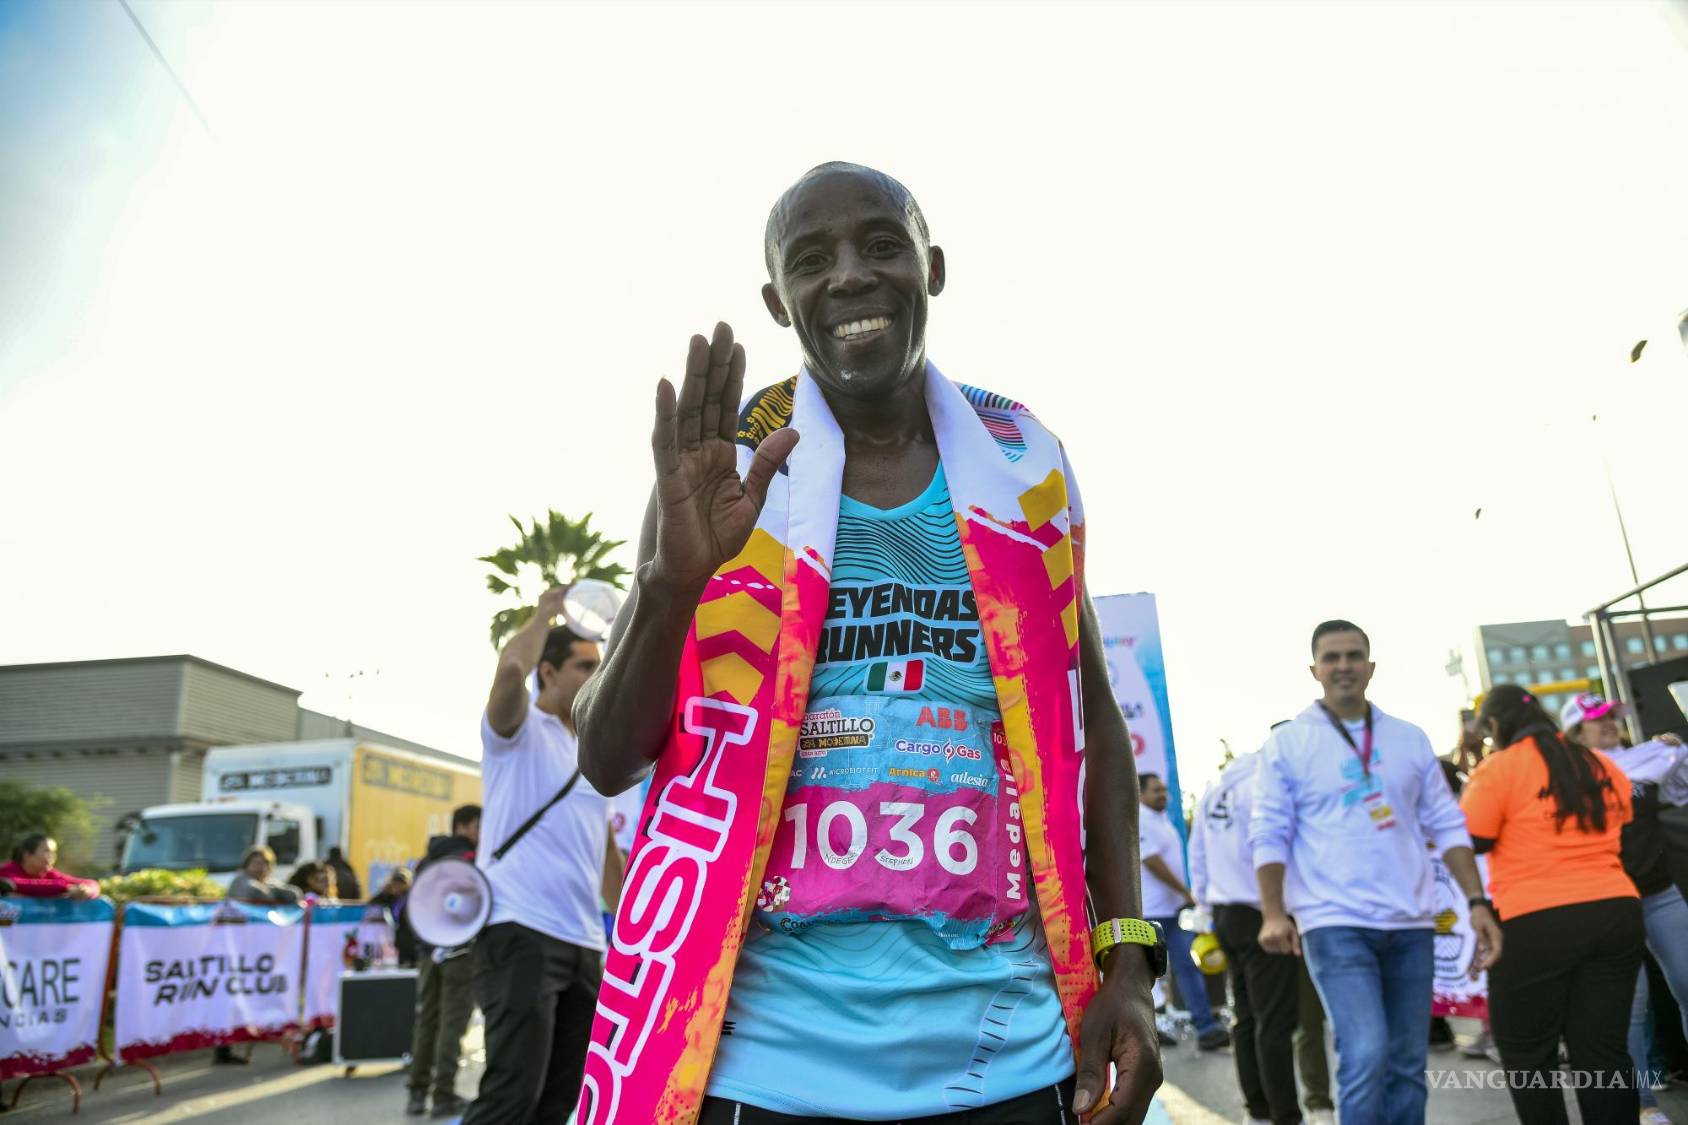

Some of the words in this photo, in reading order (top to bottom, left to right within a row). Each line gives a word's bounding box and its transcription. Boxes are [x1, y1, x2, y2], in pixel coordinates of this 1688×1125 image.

[827, 583, 981, 621] EYENDAS
[801, 718, 874, 737] SALTILLO
[916, 706, 968, 731] ABB
[896, 740, 941, 755] Cargo
[957, 745, 981, 760] Gas
[784, 800, 978, 876] 1036
[225, 974, 287, 996] CLUB
